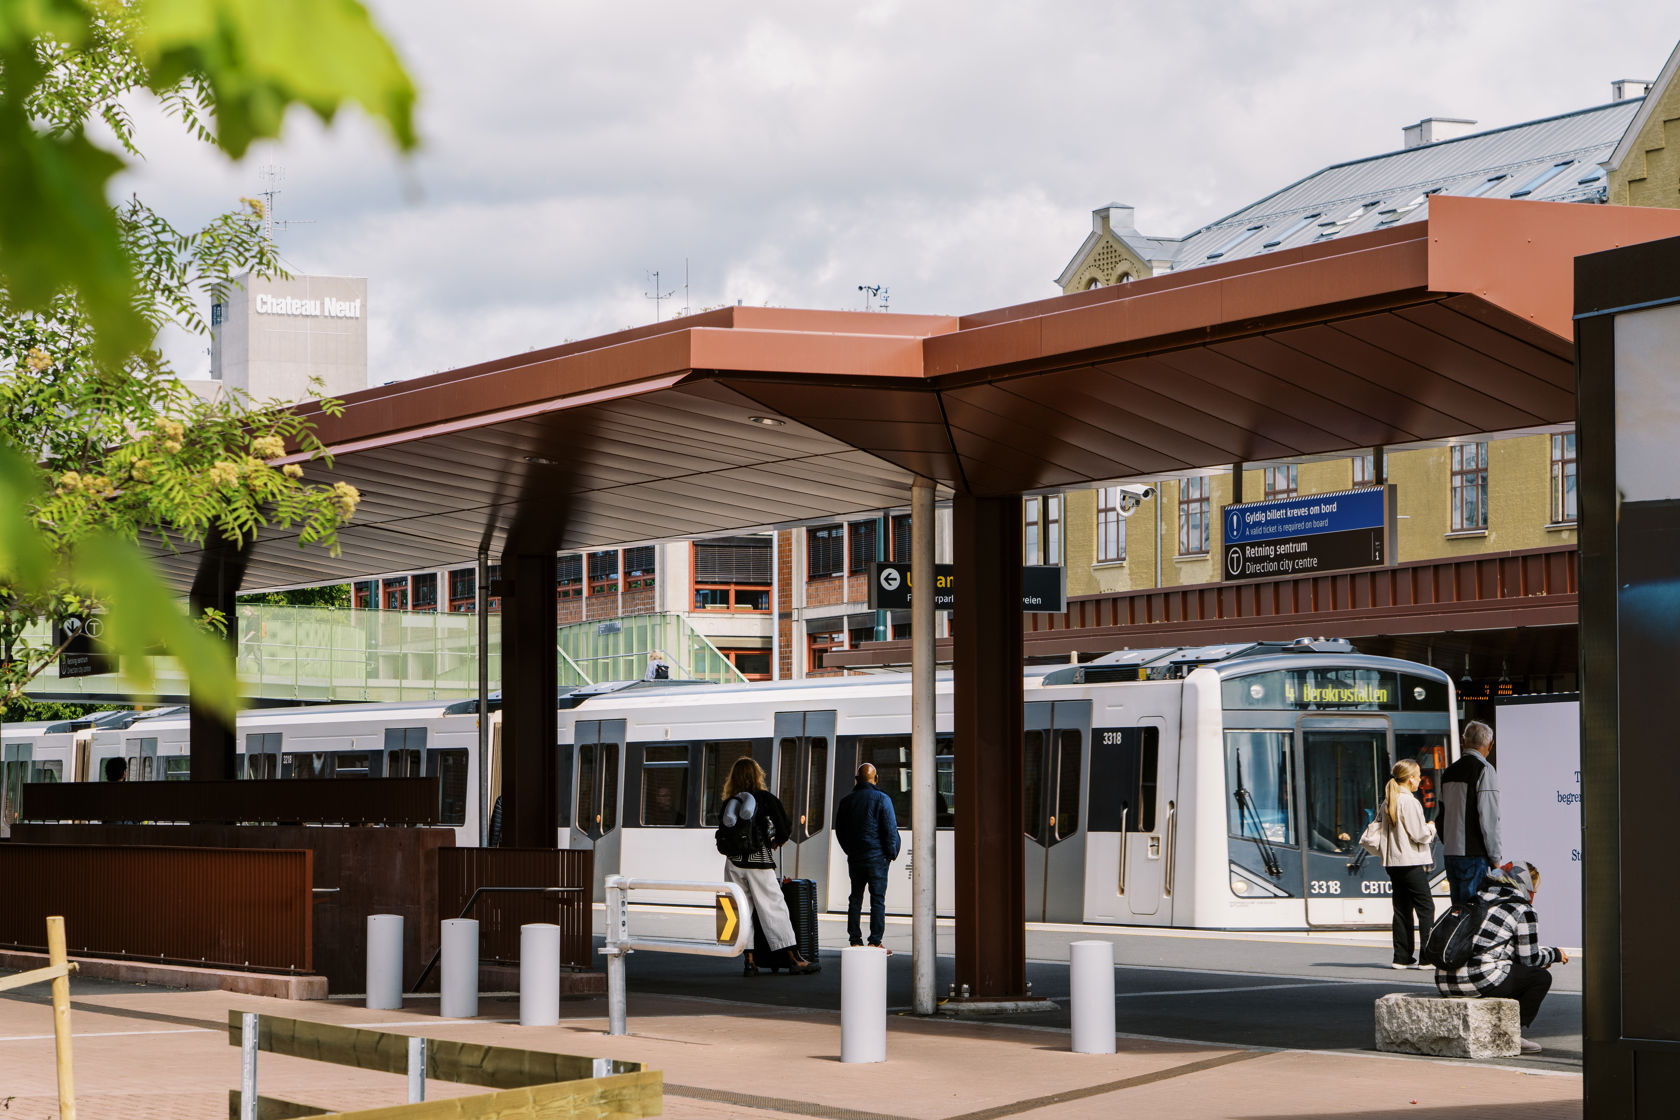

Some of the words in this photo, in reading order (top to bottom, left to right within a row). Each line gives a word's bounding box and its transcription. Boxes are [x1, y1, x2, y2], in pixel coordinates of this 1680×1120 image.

[256, 293, 321, 316] Chateau
[324, 297, 361, 319] Neuf
[1245, 512, 1265, 524] Gyldig
[1267, 509, 1286, 520] billett
[1287, 507, 1308, 518] kreves
[1310, 506, 1320, 515] om
[1321, 502, 1337, 513] bord
[1245, 527, 1250, 536] A
[1250, 526, 1262, 535] valid
[1263, 525, 1277, 534] ticket
[1278, 524, 1282, 532] is
[1283, 521, 1304, 532] required
[1306, 521, 1312, 529] on
[1313, 518, 1328, 528] board
[1245, 544, 1274, 558] Retning
[1276, 541, 1308, 555] sentrum
[1245, 560, 1278, 574] Direction
[1279, 558, 1293, 572] city
[1294, 557, 1318, 569] centre
[1285, 683, 1295, 702] 4
[1303, 683, 1387, 703] Bergkrystallen
[1103, 732, 1122, 745] 3318
[1574, 771, 1581, 783] T
[1571, 849, 1582, 861] St
[1310, 880, 1341, 895] 3318
[1361, 881, 1393, 894] CBTC
